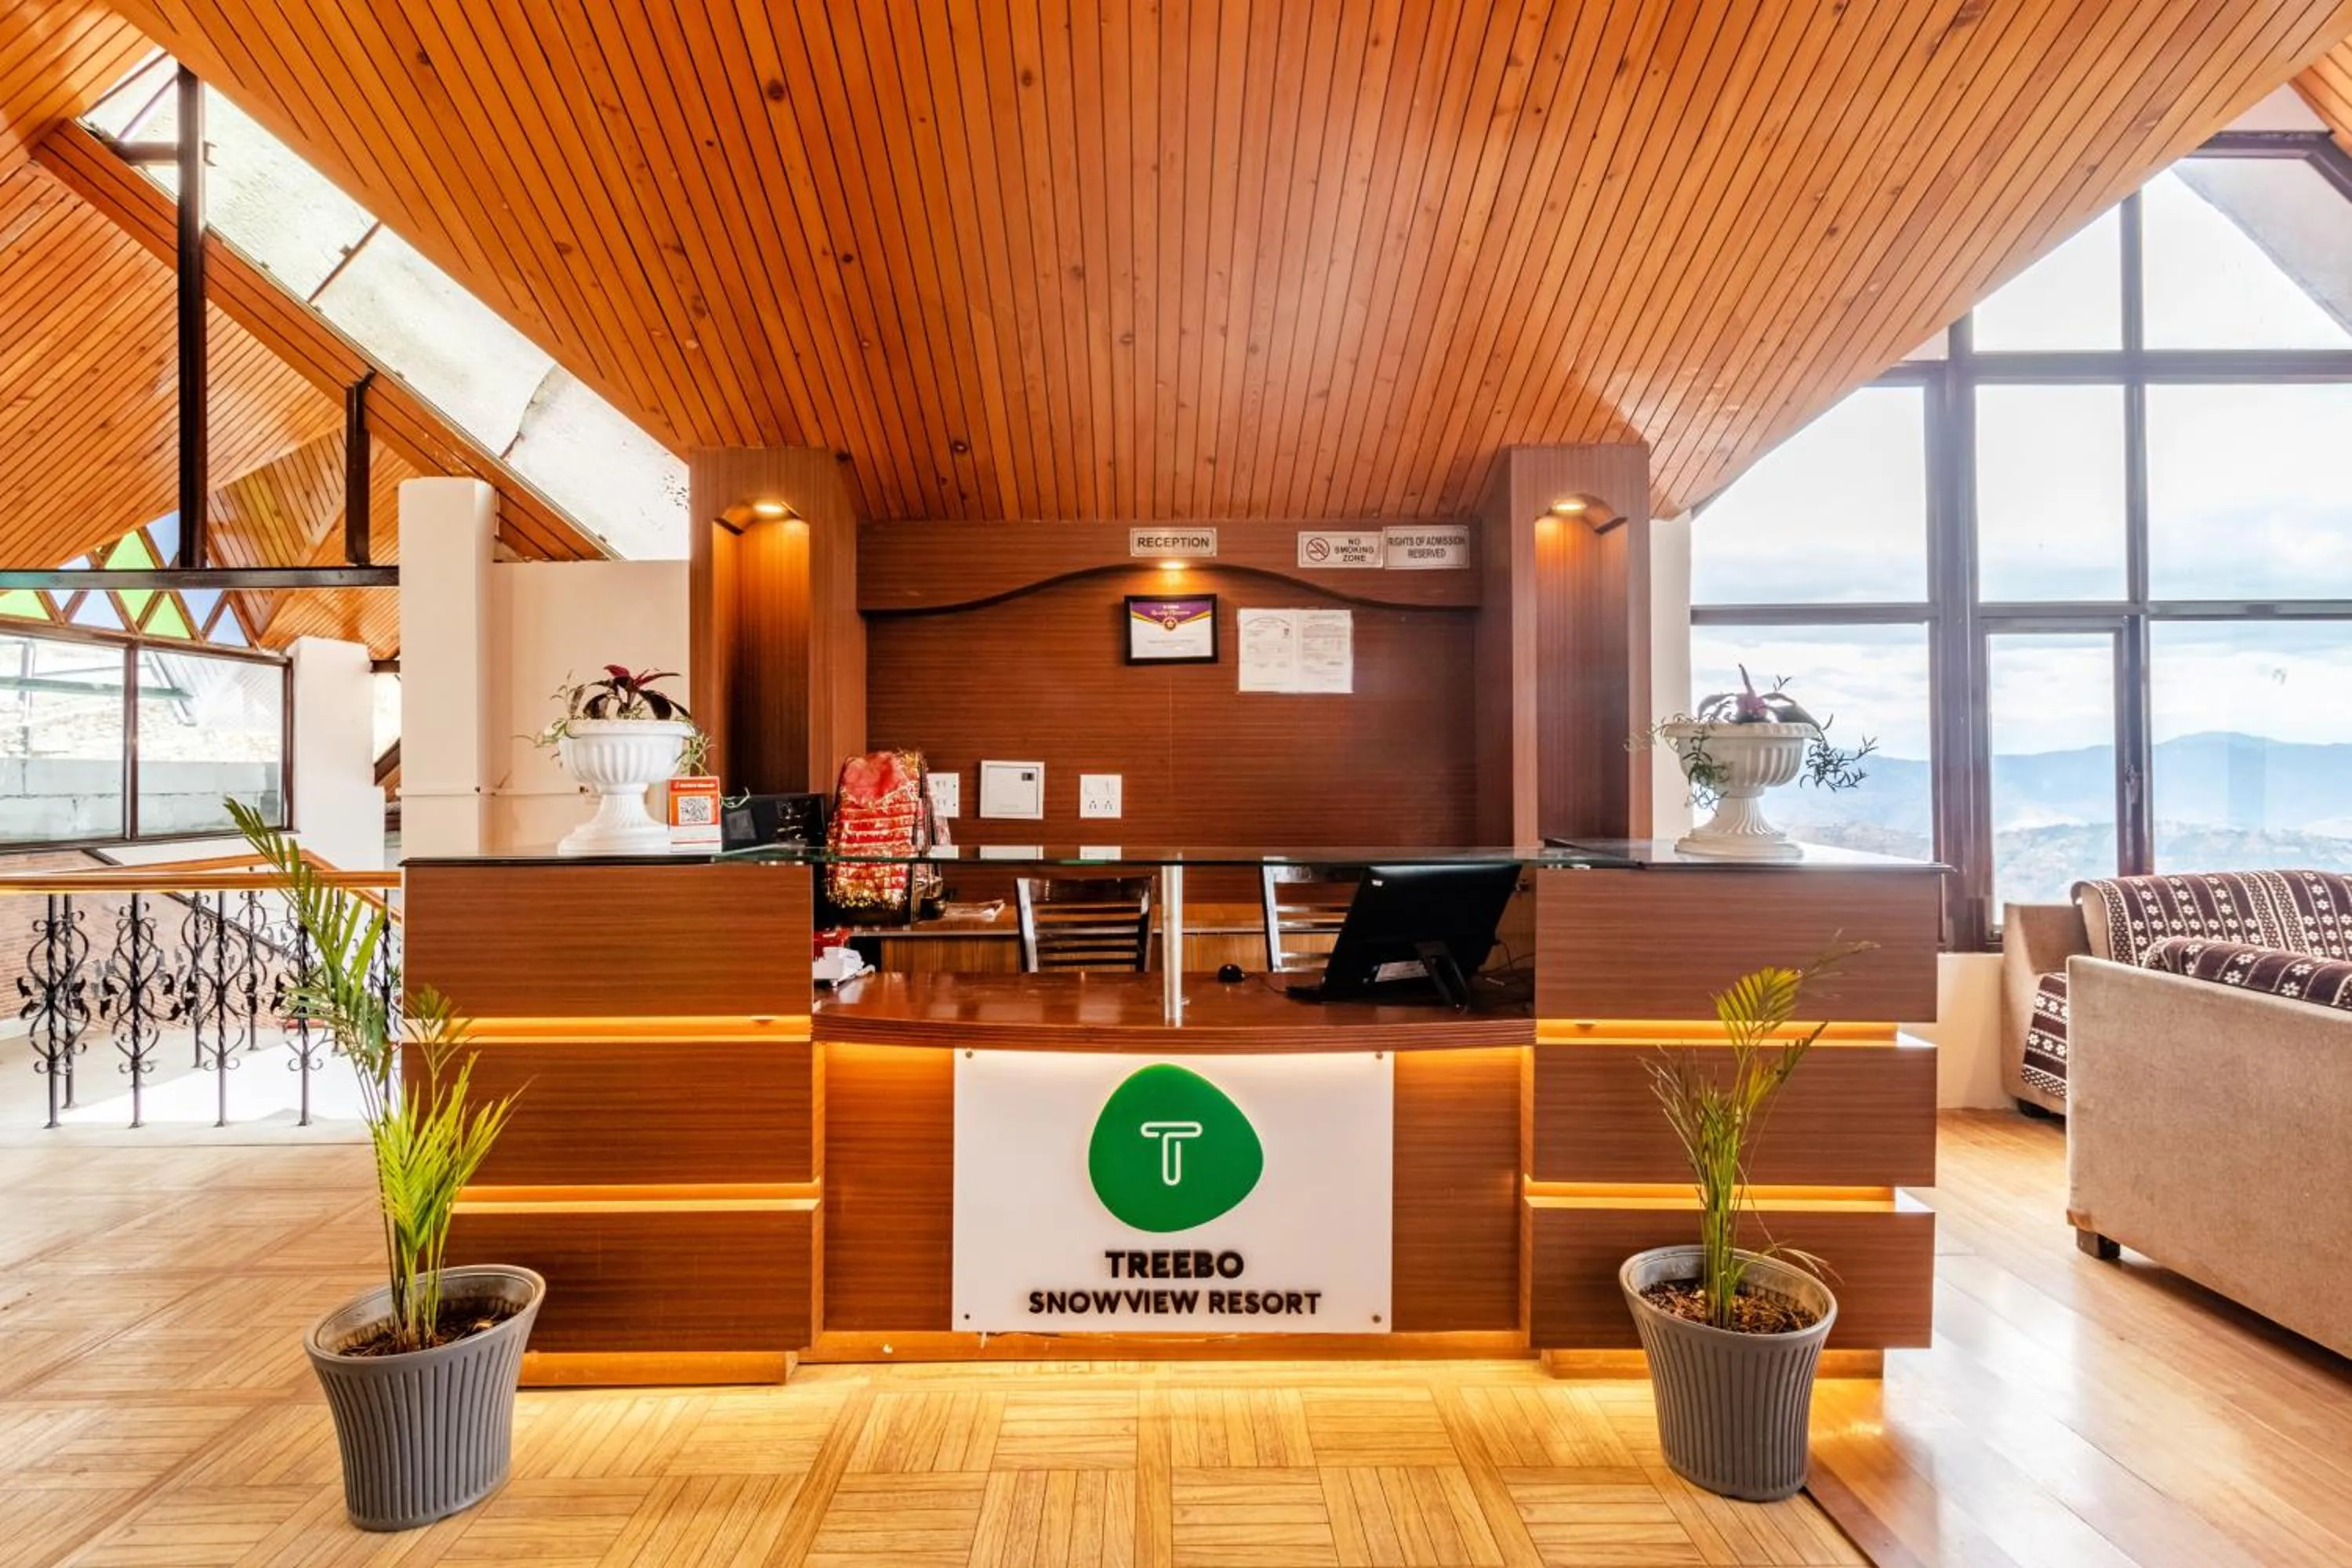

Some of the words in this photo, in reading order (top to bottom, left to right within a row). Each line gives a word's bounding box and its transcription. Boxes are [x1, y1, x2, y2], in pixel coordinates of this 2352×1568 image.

[1138, 536, 1210, 548] RECEPTION
[1388, 537, 1414, 546] RIGHTS
[1415, 538, 1425, 546] OF
[1426, 536, 1465, 546] ADMISSION
[1408, 549, 1446, 559] RESERVED
[1141, 1121, 1203, 1186] T
[1105, 1250, 1245, 1279] TREEBO
[1028, 1289, 1200, 1315] SNOWVIEW
[1208, 1290, 1322, 1315] RESORT
